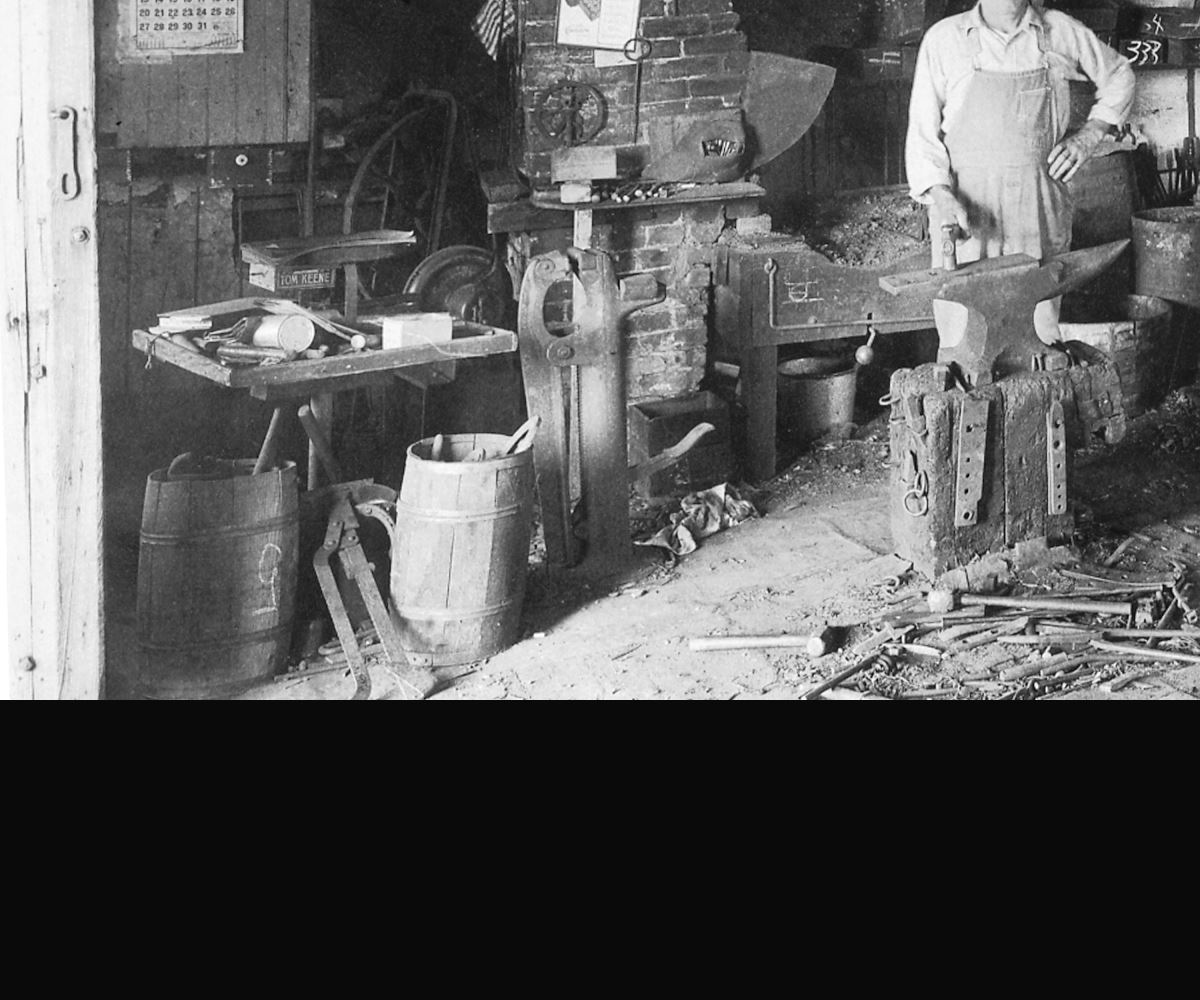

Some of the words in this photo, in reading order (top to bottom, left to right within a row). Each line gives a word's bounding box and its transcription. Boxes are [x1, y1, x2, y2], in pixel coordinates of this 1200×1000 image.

[139, 9, 150, 17] 20
[154, 8, 164, 17] 21
[168, 9, 178, 17] 22
[182, 8, 194, 16] 23
[196, 8, 207, 16] 24
[211, 8, 222, 16] 25
[225, 7, 235, 16] 26
[139, 23, 150, 31] 27
[154, 23, 164, 31] 28
[168, 22, 179, 31] 29
[183, 22, 193, 30] 30
[198, 22, 207, 30] 31
[280, 273, 298, 286] TOM
[301, 271, 330, 285] KEENE
